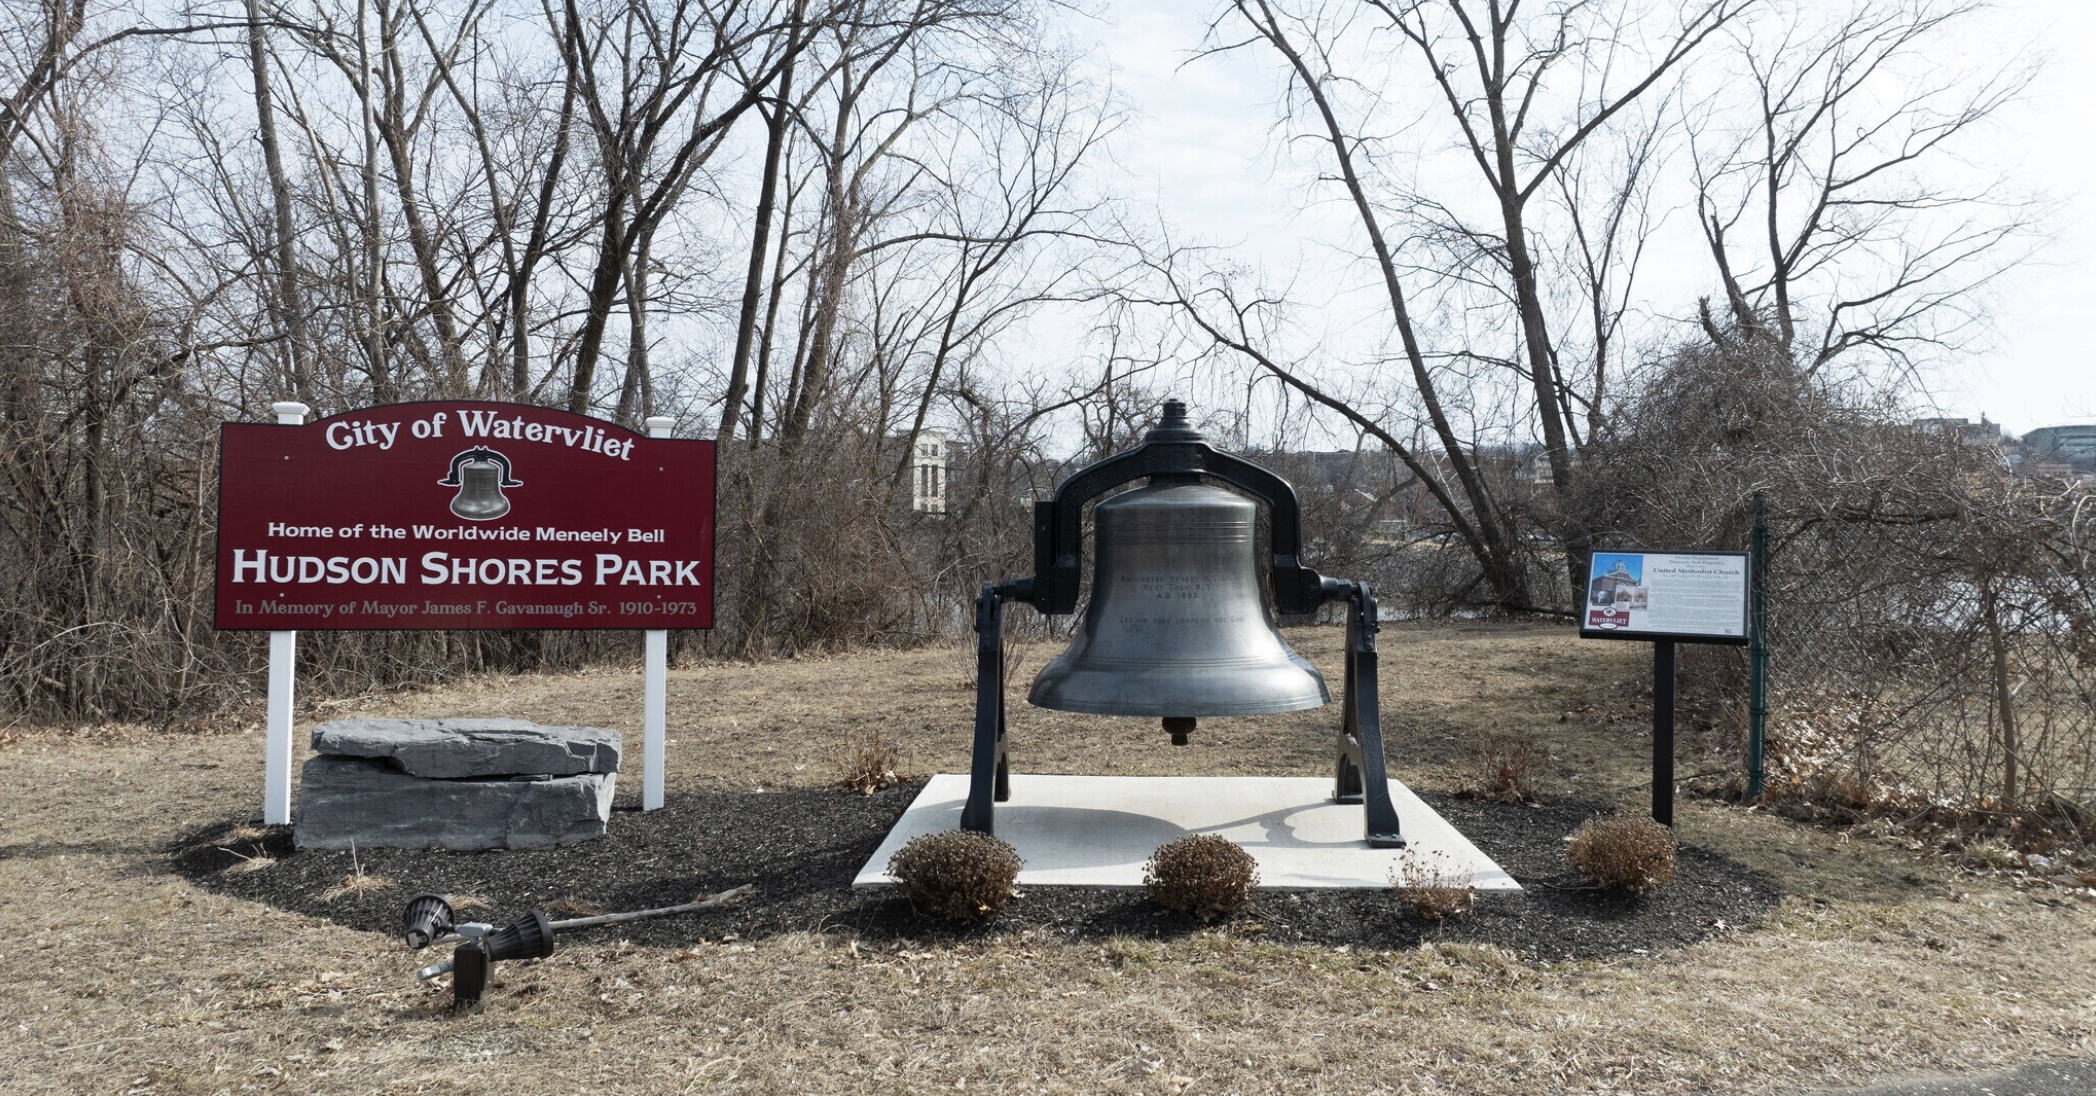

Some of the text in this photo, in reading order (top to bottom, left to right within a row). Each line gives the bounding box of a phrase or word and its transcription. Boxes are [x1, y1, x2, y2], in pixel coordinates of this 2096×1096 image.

[325, 410, 633, 461] City of Watervliet
[268, 522, 665, 545] Home of the Worldwide Meneely Bell
[231, 548, 701, 586] HUDSON SHORES PARK
[235, 600, 253, 614] In
[258, 600, 334, 618] Memory
[338, 600, 357, 615] of
[360, 601, 418, 618] Mayor
[421, 601, 471, 615] James
[476, 601, 491, 615] F.
[587, 601, 611, 615] Sr.
[619, 601, 697, 616] 1910-1973
[1591, 616, 1628, 625] WATERVLIET
